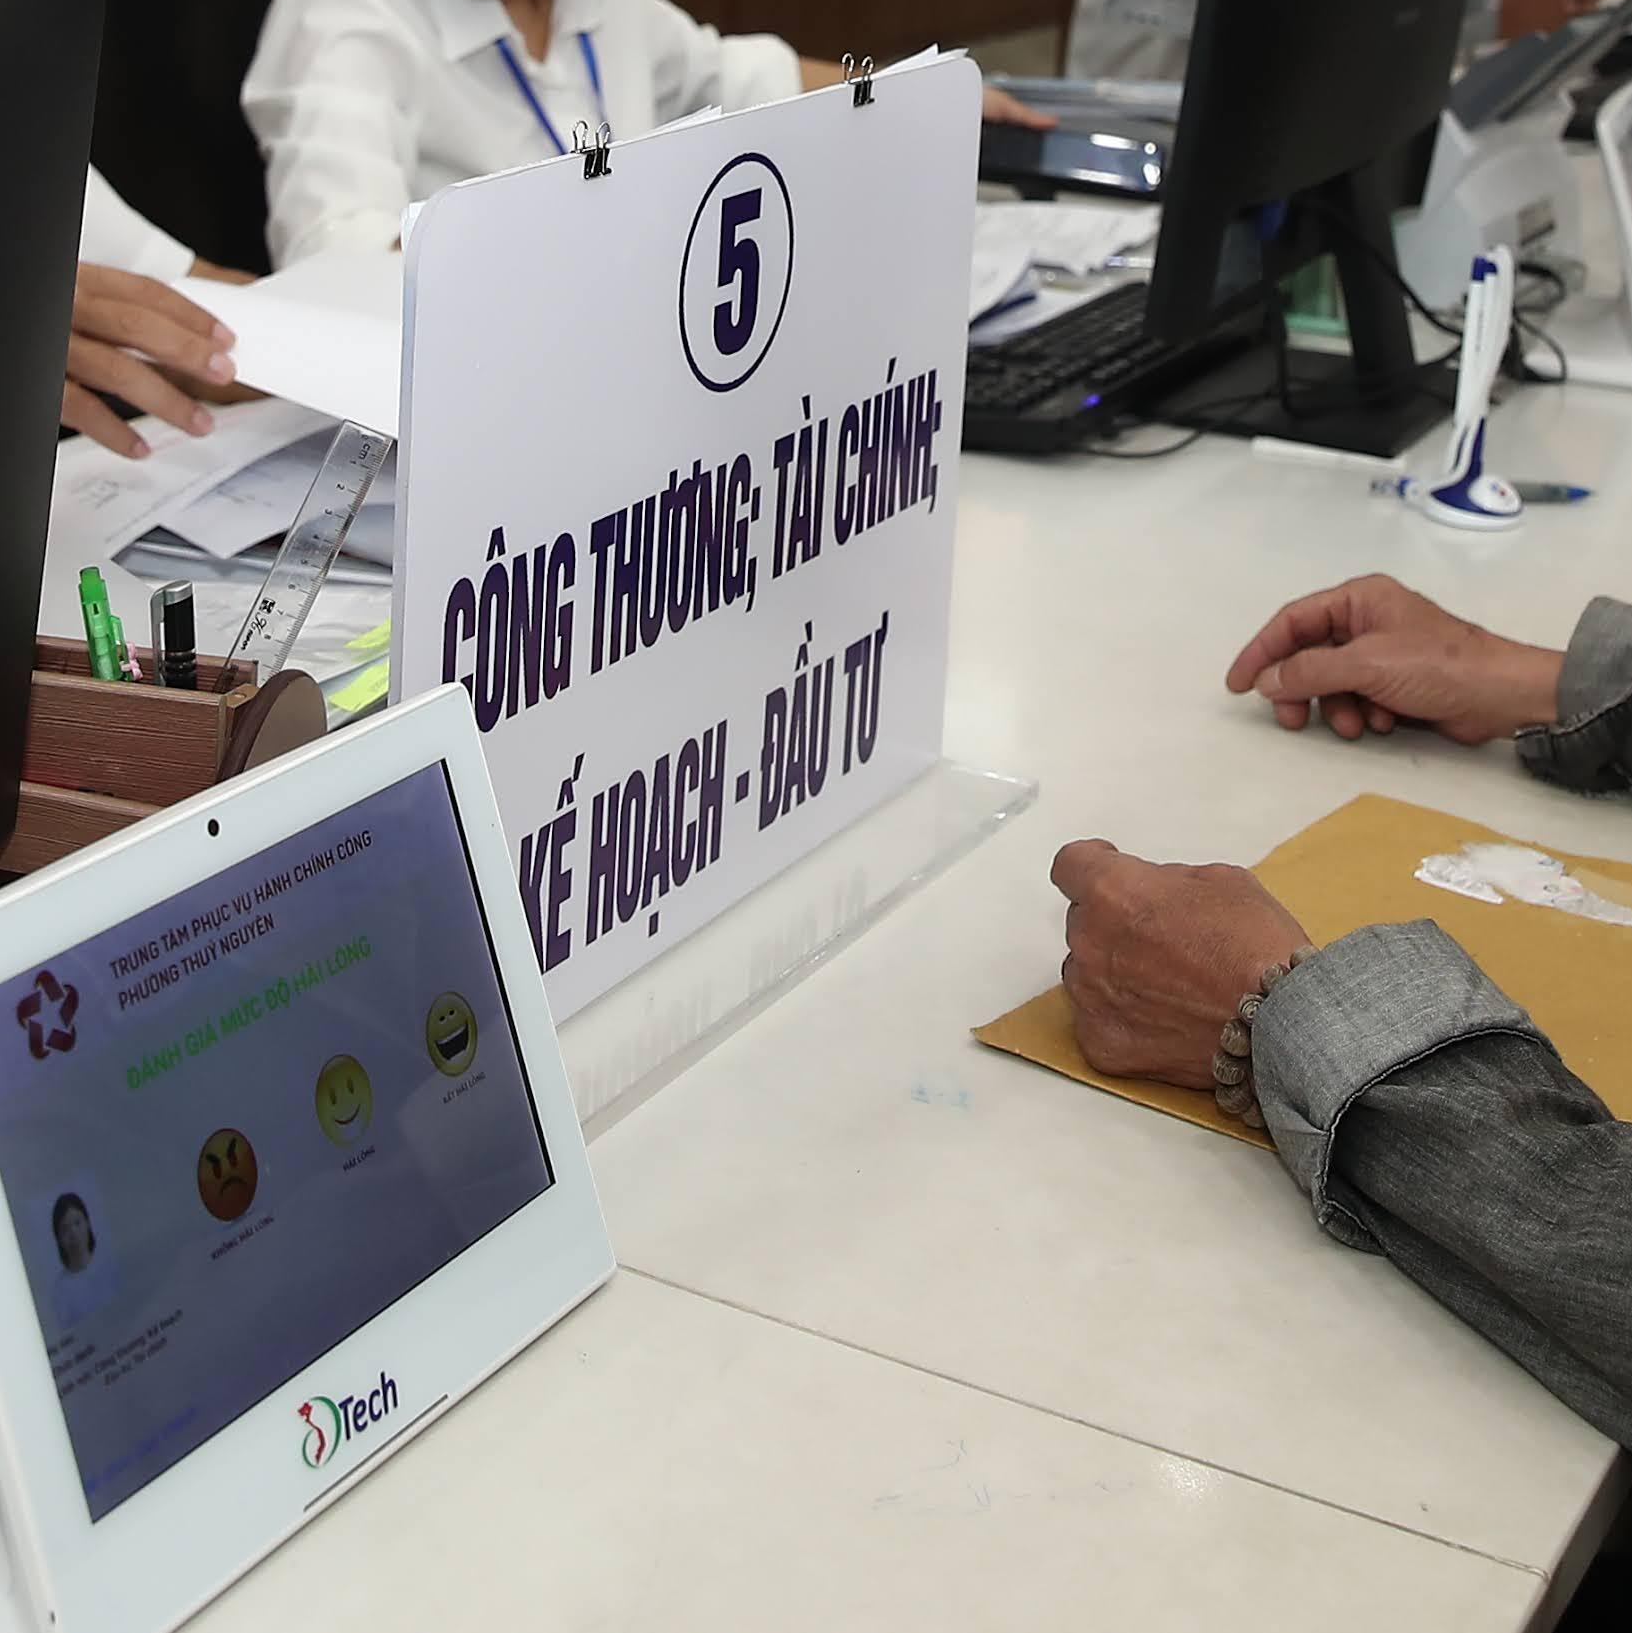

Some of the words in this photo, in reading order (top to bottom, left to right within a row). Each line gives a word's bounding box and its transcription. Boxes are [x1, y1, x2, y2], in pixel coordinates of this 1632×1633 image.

[713, 188, 762, 355] 5
[357, 442, 371, 461] cm
[442, 526, 575, 732] CÔNG
[591, 459, 761, 675] THƯƠNG;
[773, 395, 828, 580] TÀI
[834, 357, 942, 545] CHÍNH;
[519, 753, 584, 975] KẾ
[586, 719, 727, 938] HOẠCH
[759, 620, 834, 831] ĐẦU
[843, 610, 889, 775] TƯ
[109, 941, 160, 980] TRUNG
[160, 925, 190, 953] TÂM
[191, 903, 232, 938] PHỤC
[232, 892, 253, 916] VỤ
[254, 871, 293, 905] HÀNH
[293, 849, 335, 884] CHÍNH
[337, 829, 373, 861] CÔNG
[220, 913, 275, 955] NGUYÊN
[266, 975, 292, 1011] ĐỘ
